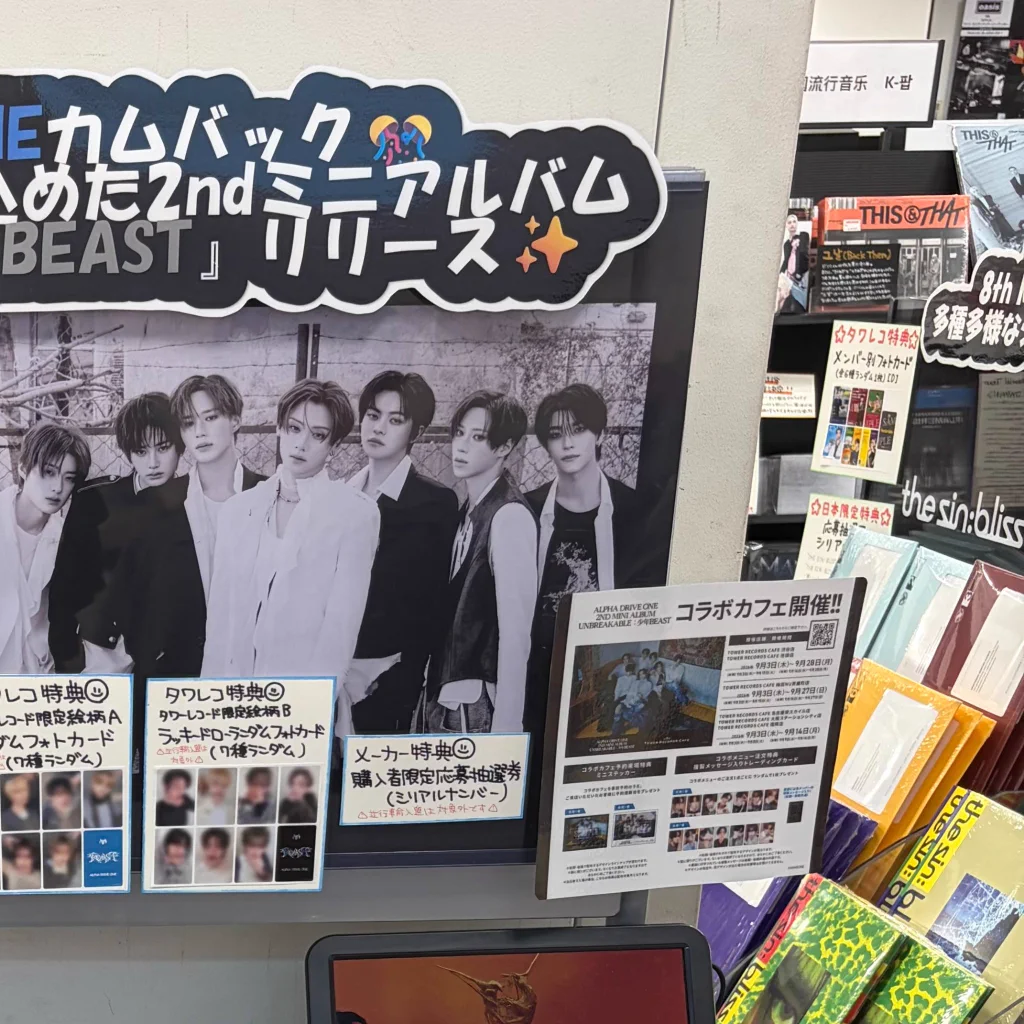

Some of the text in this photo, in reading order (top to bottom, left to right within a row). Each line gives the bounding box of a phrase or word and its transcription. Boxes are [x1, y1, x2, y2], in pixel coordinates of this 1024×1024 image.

[884, 74, 913, 90] K-팝
[960, 130, 990, 141] THIS
[859, 205, 903, 224] THIS
[919, 198, 969, 228] THAT
[978, 270, 1013, 305] 8th
[902, 475, 936, 523] the
[816, 537, 843, 552] シリア
[593, 602, 658, 613] ALPHA DRIVE ONE
[595, 610, 656, 621] 2ND MINI ALBUM
[676, 593, 843, 622] コラボカフェ開催!!
[578, 619, 632, 630] UNBREAKABLE
[166, 681, 265, 704] タワレコ特典
[354, 739, 453, 763] メーカー特典
[351, 760, 522, 788] 購入者限定応募抽選券
[947, 799, 983, 841] the
[917, 842, 950, 887] sin:
